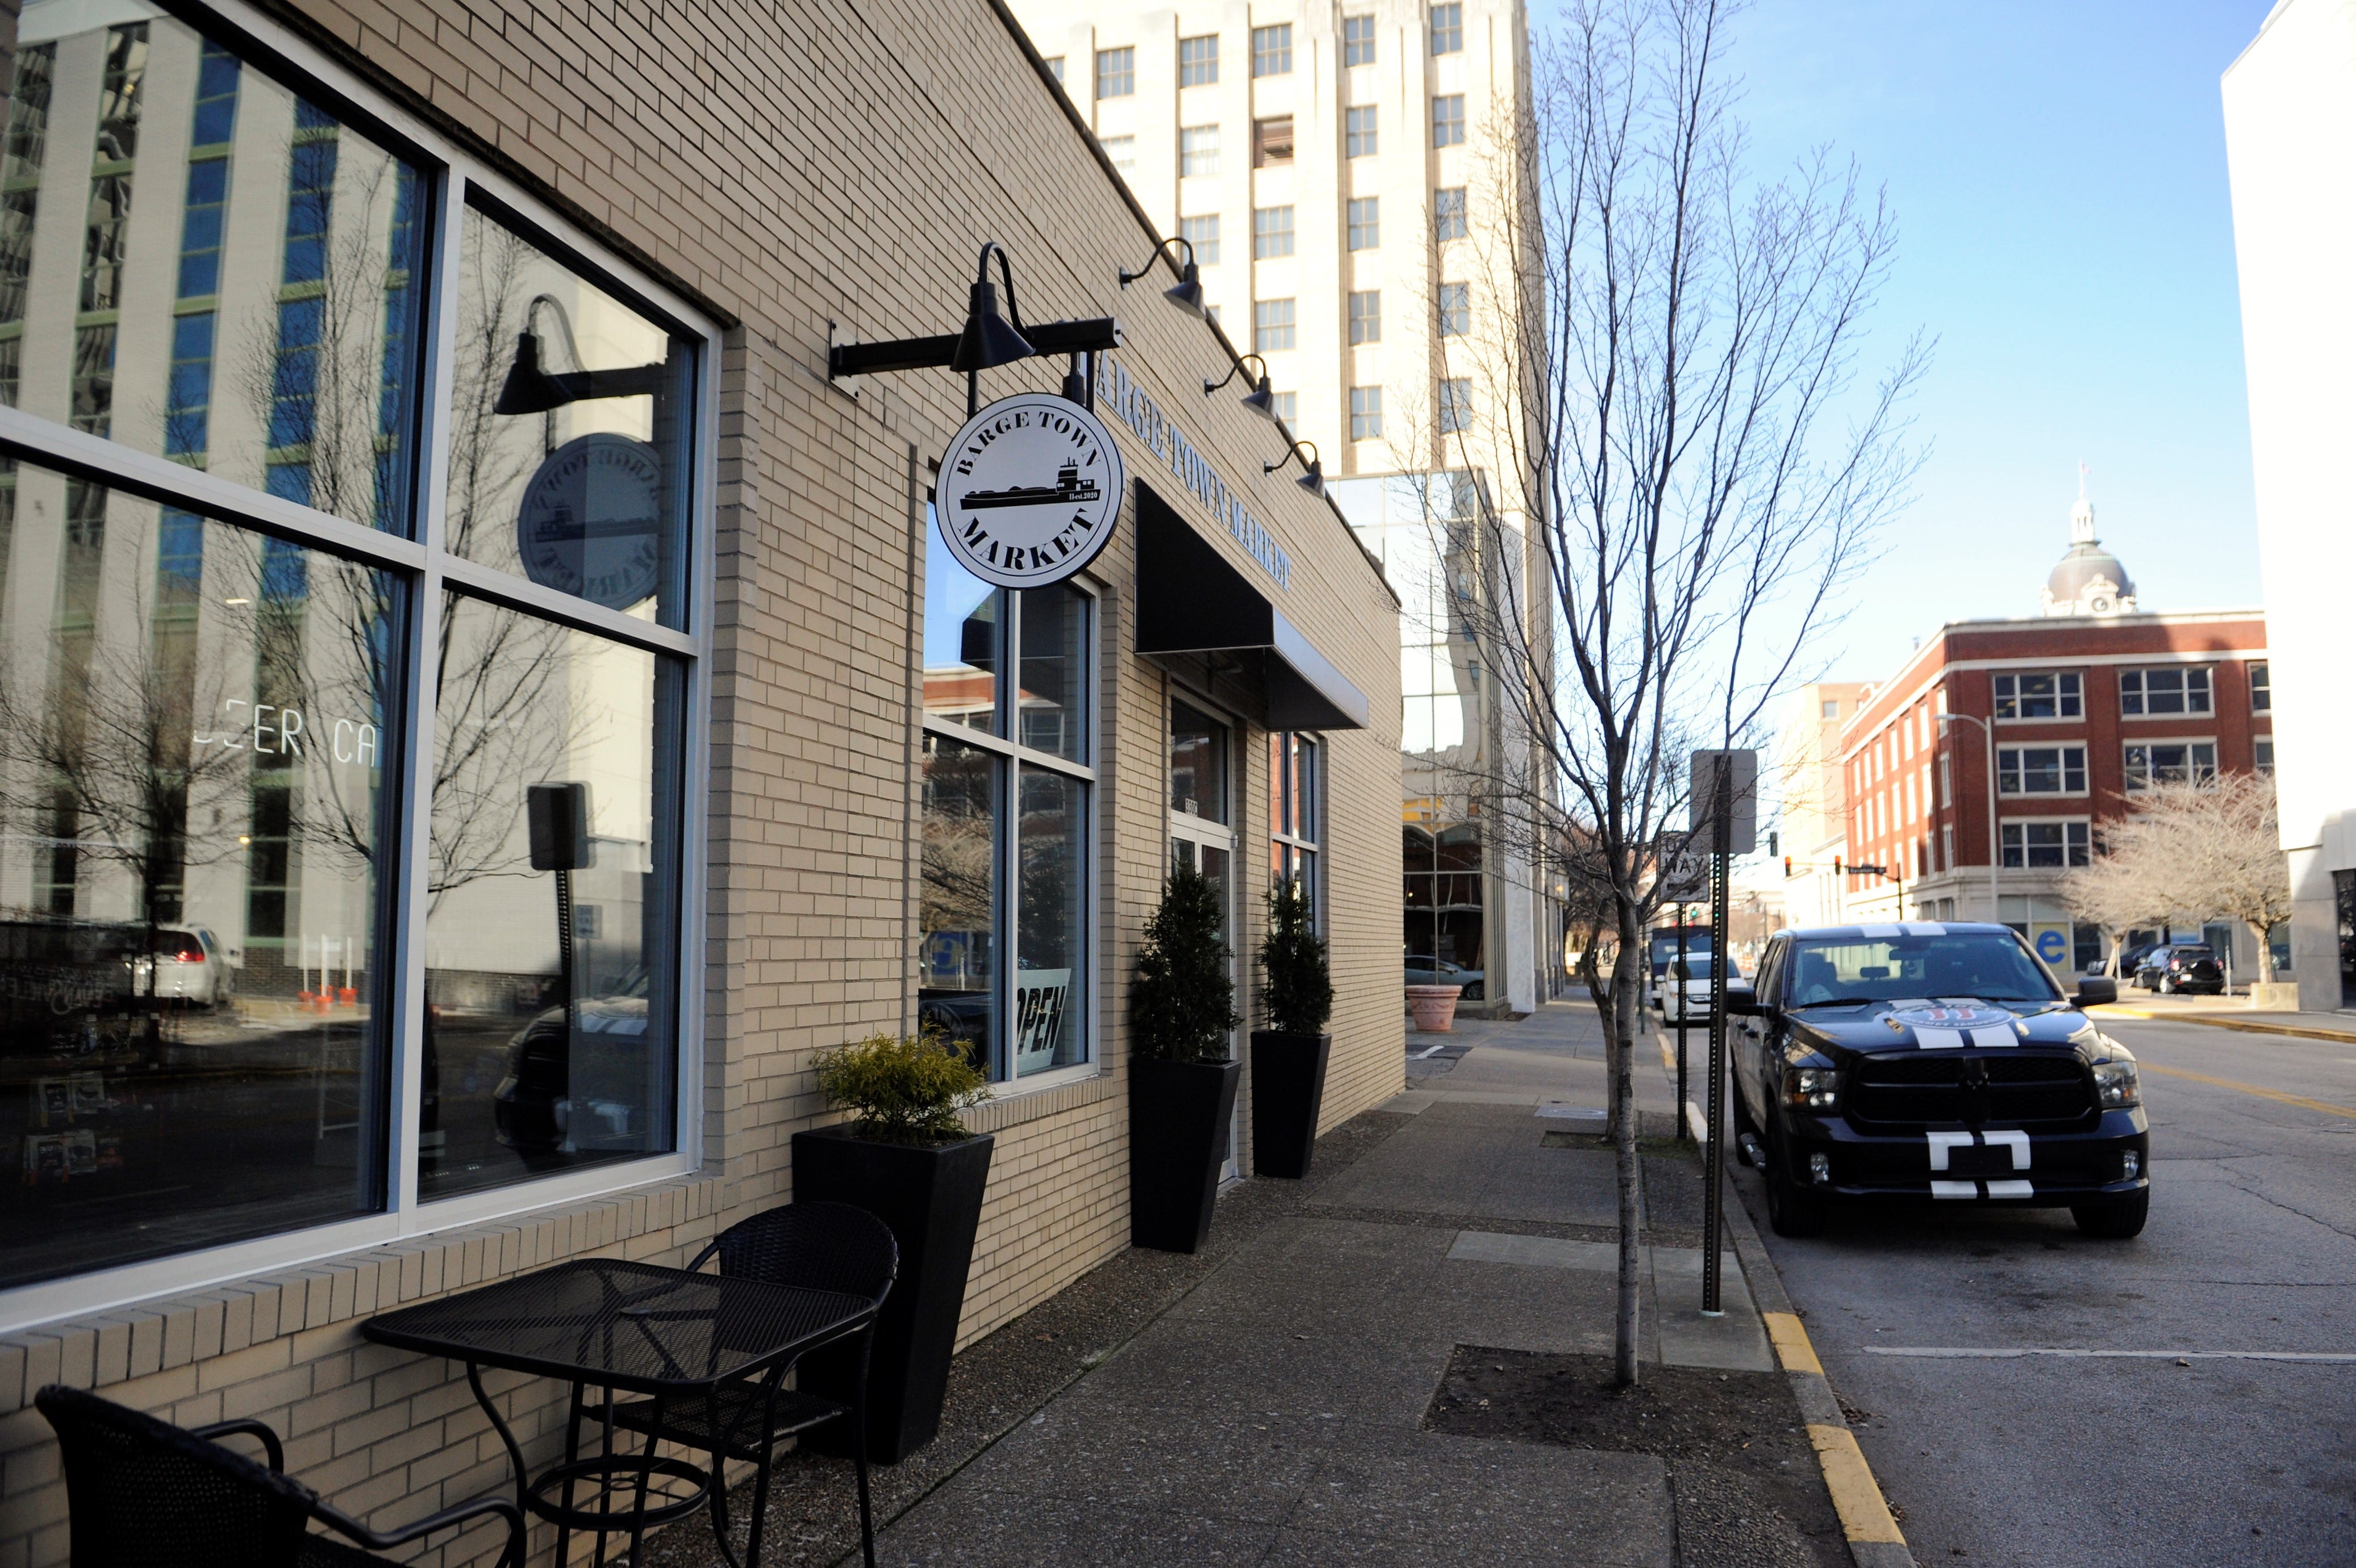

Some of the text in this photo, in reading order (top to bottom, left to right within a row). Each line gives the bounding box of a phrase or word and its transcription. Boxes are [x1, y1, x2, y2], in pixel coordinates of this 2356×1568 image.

[956, 411, 1102, 477] BARGE TOWN
[957, 507, 1096, 570] MARKET
[1168, 422, 1227, 526] TOWN
[1229, 492, 1291, 593] MARKET
[193, 699, 302, 757] EER
[2037, 930, 2066, 964] e
